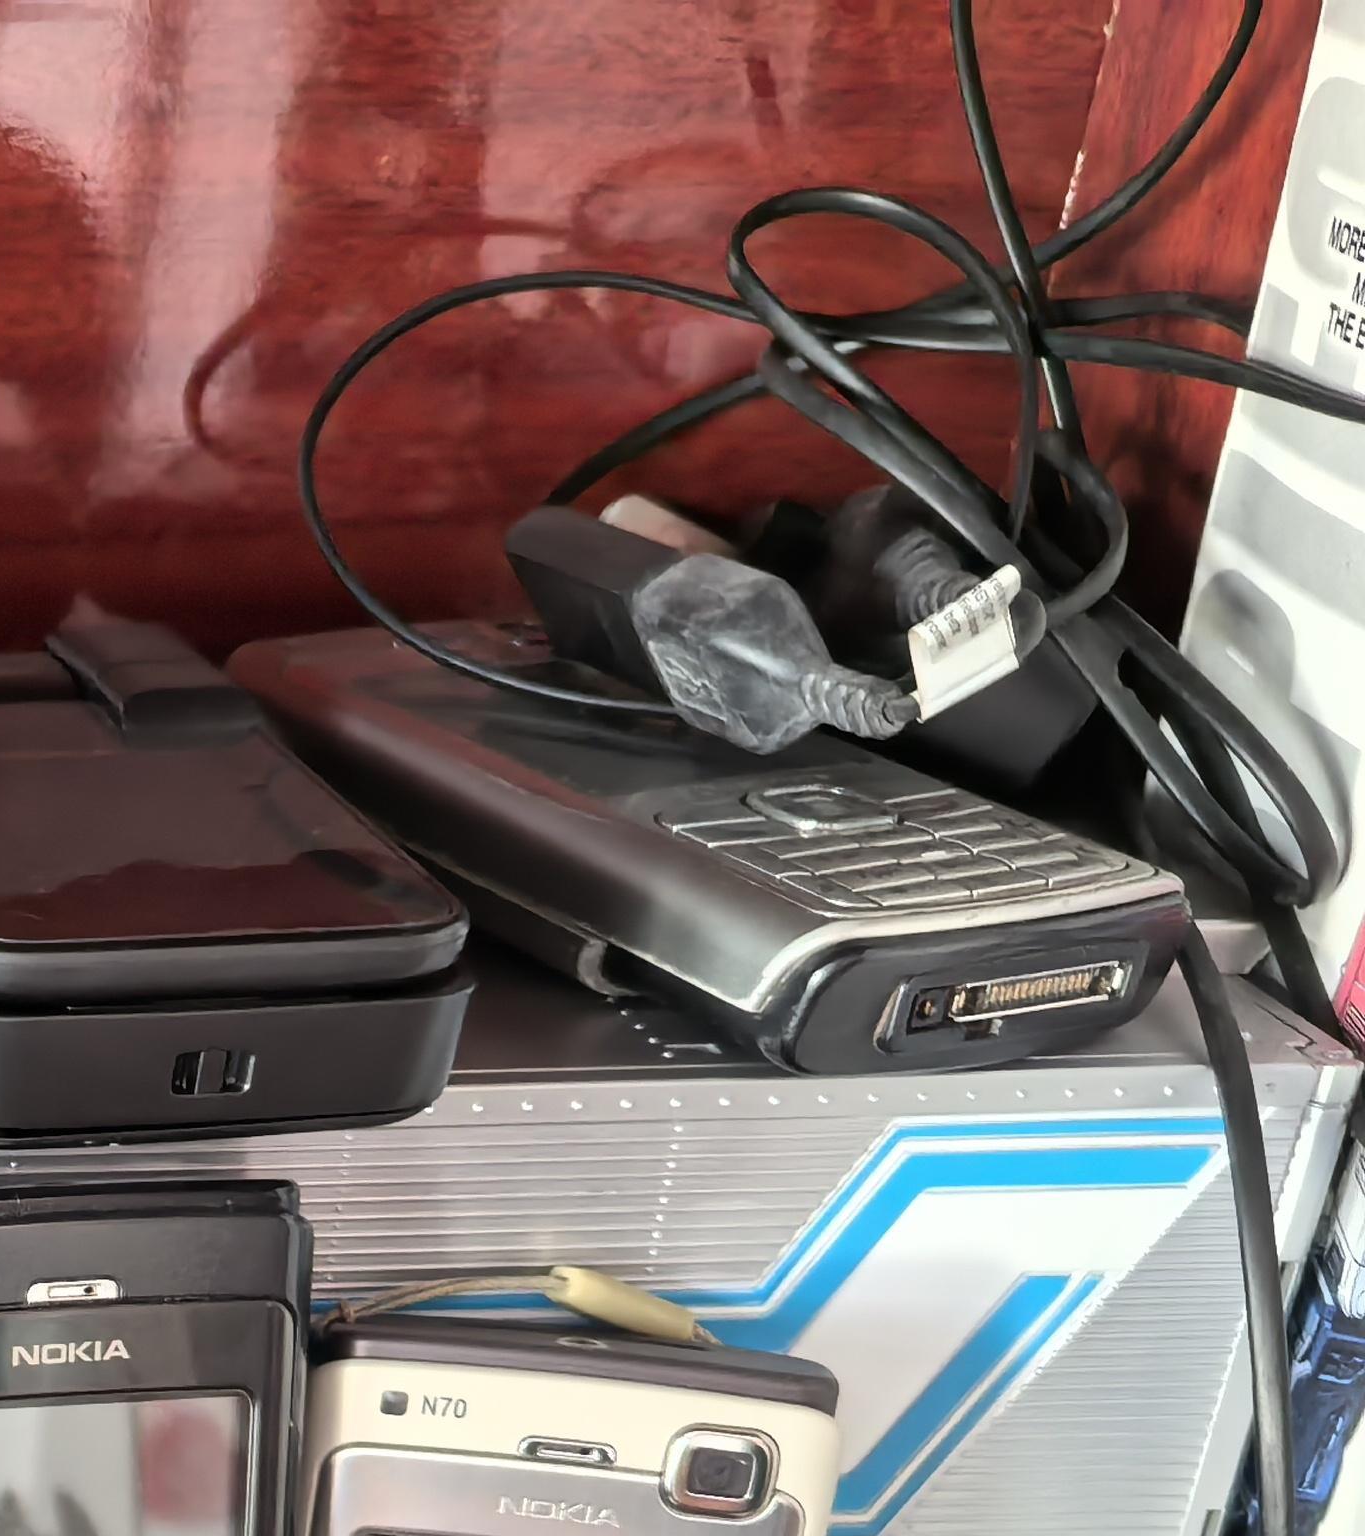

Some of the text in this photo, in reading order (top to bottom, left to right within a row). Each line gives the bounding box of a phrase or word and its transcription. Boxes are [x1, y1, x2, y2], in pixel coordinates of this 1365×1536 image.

[1328, 302, 1356, 343] THE
[12, 1340, 131, 1367] NOKIA
[421, 1396, 467, 1419] N70
[496, 1495, 621, 1528] NOKIA
